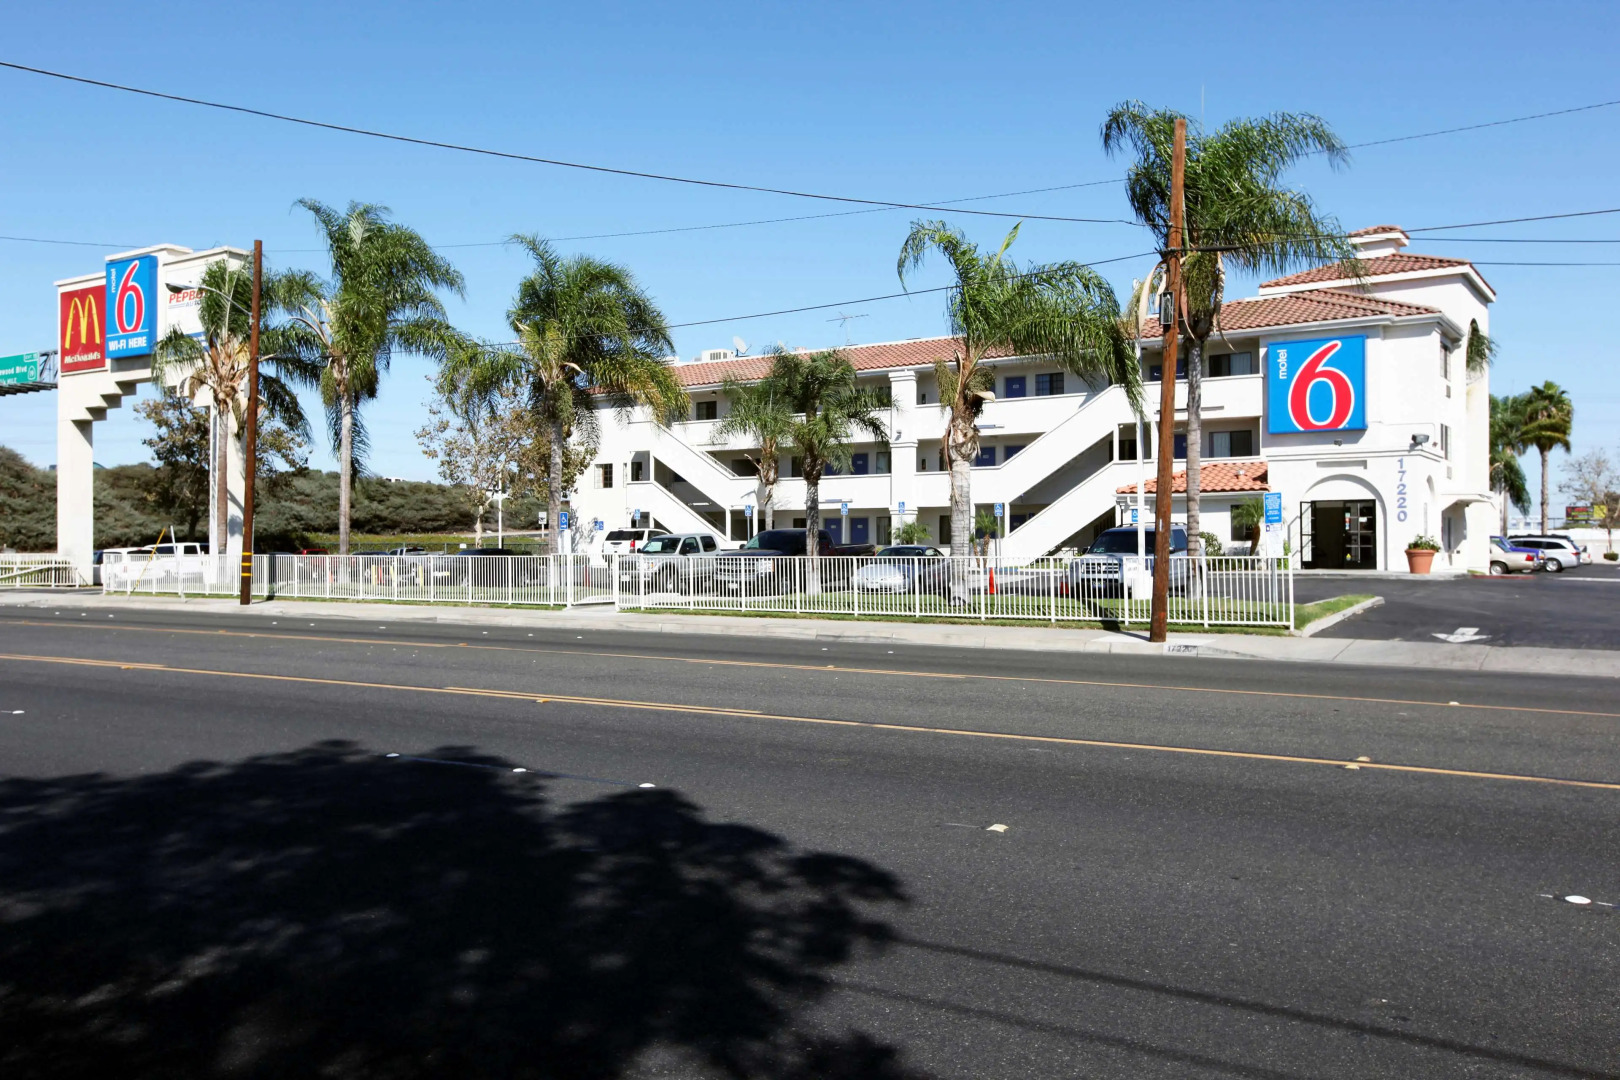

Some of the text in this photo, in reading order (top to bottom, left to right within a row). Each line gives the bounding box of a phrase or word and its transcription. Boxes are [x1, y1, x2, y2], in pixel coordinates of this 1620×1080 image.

[116, 260, 144, 333] 6
[65, 352, 100, 363] McDonald's
[108, 336, 147, 351] WI-FI HERE
[1278, 340, 1354, 431] motel 6
[1396, 457, 1408, 523] 17220
